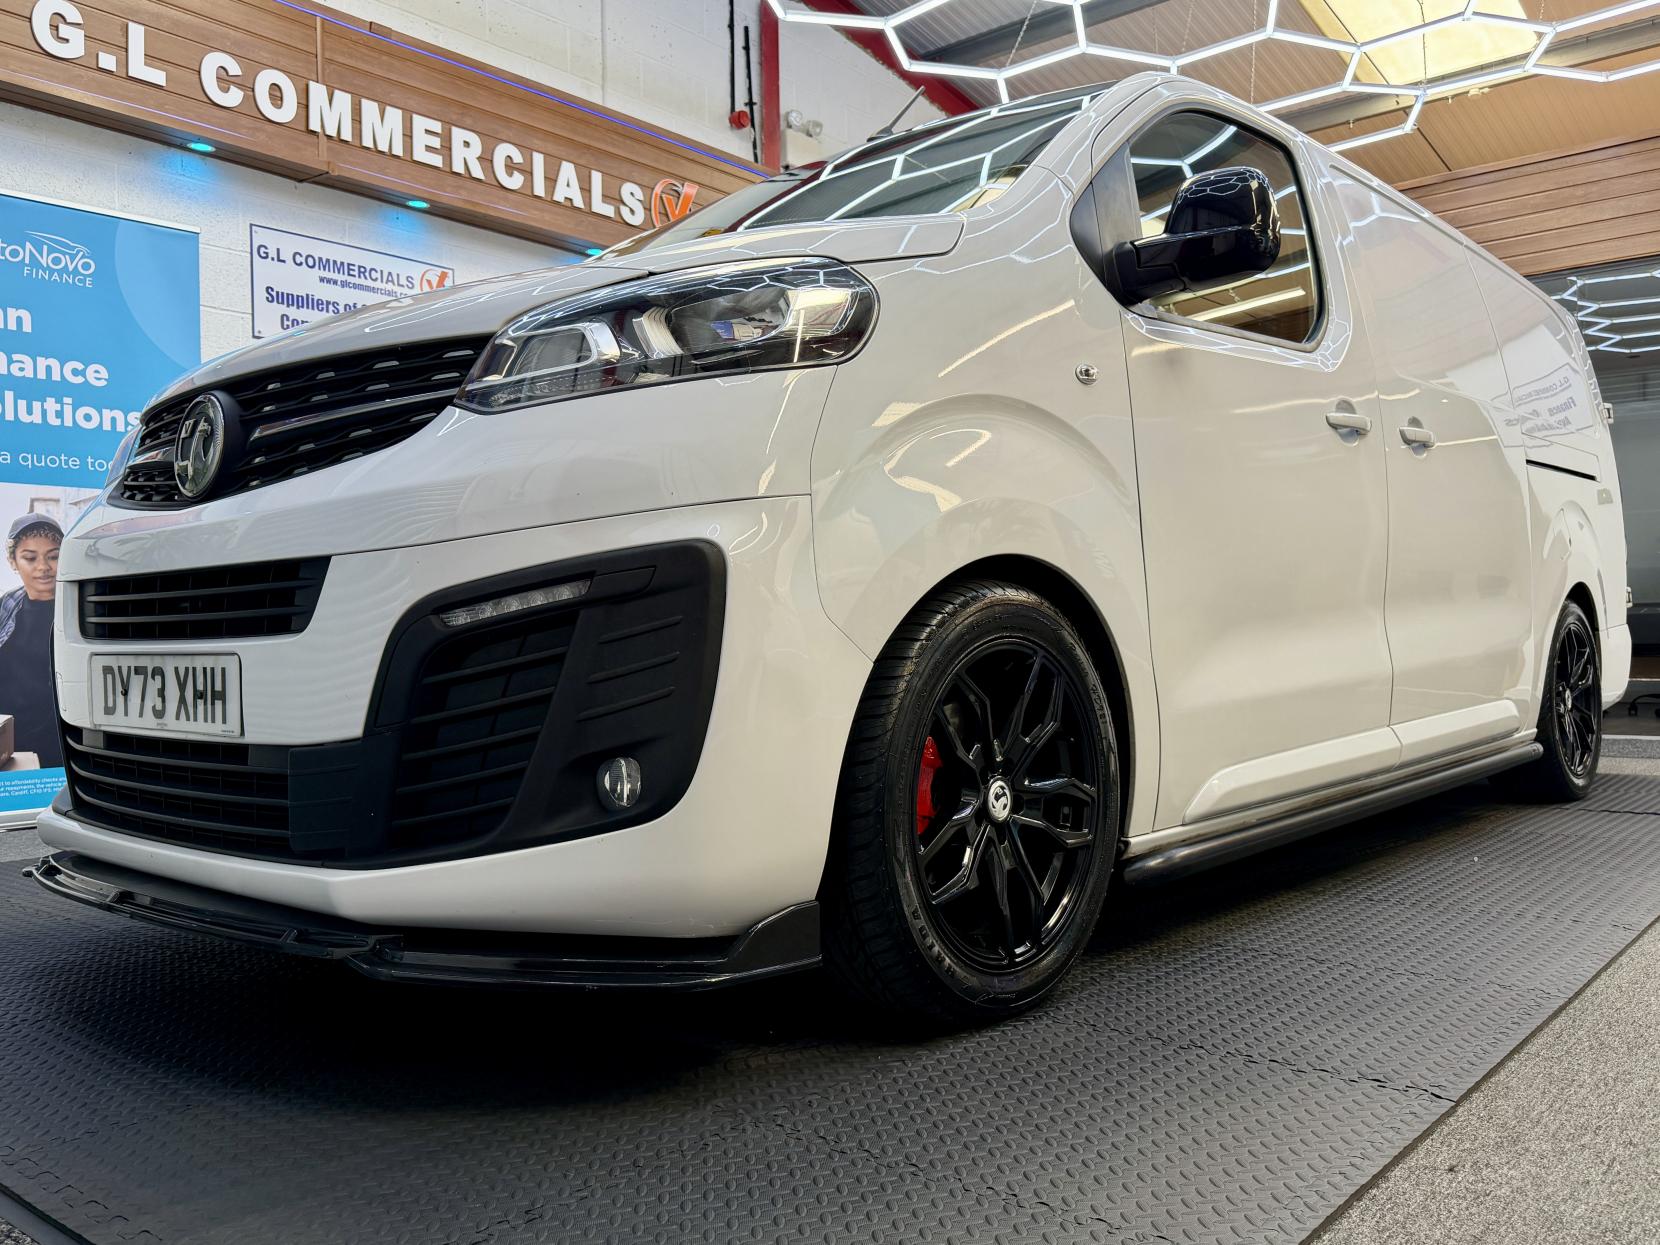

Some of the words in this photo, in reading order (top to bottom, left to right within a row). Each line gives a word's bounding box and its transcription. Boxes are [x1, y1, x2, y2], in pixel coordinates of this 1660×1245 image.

[30, 0, 166, 87] G.L
[200, 51, 646, 227] COMMERCIALS
[24, 266, 93, 288] FINANCE
[256, 244, 286, 264] G.L
[292, 251, 415, 290] COMMERCIALS
[265, 285, 340, 315] Suppliers
[280, 313, 311, 331] Co
[0, 390, 142, 434] lutions
[18, 452, 81, 469] quote
[102, 665, 166, 720] DY73
[174, 666, 227, 725] XHH
